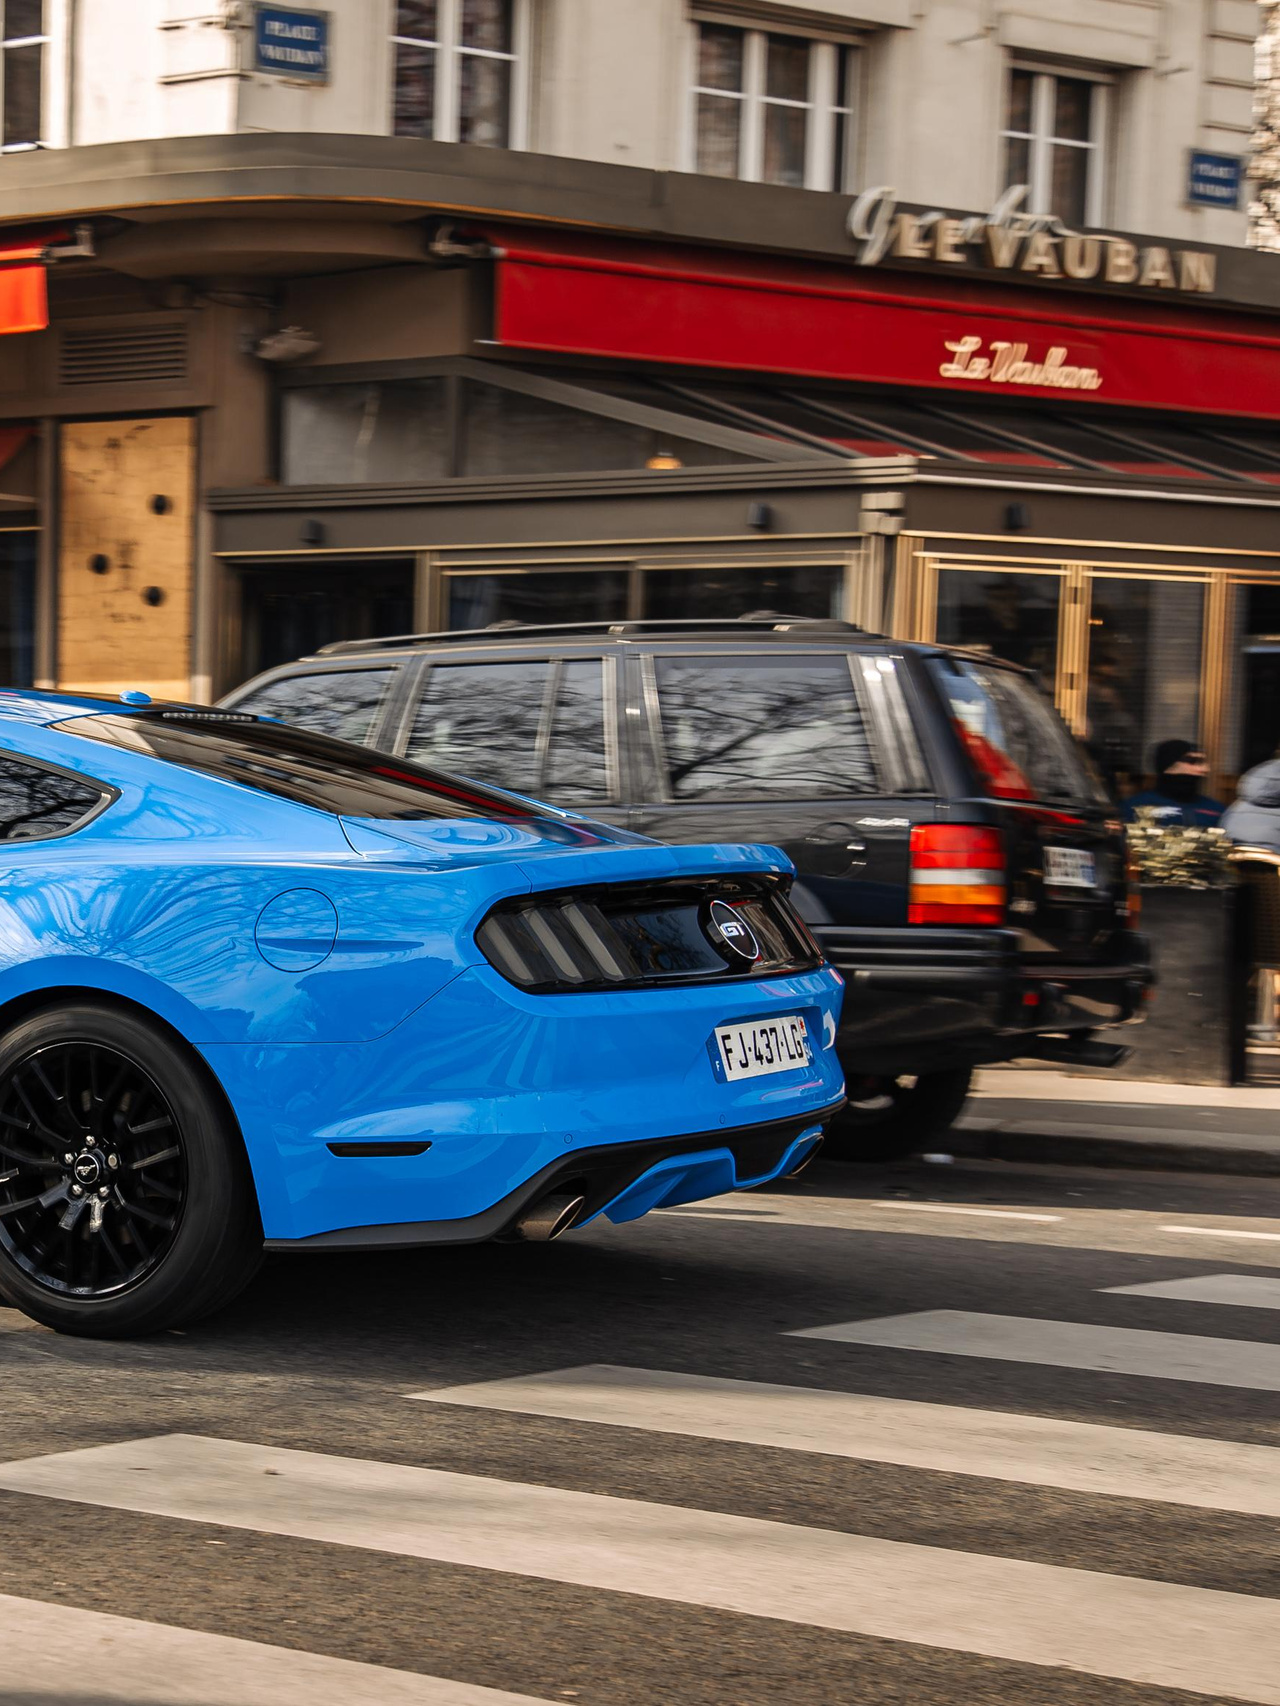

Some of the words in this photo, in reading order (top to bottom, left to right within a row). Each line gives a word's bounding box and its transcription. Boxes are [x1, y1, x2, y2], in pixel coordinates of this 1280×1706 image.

[984, 225, 1216, 292] VAUBAN
[939, 335, 990, 380] Le
[990, 341, 1103, 390] Vauban
[720, 922, 745, 937] GT
